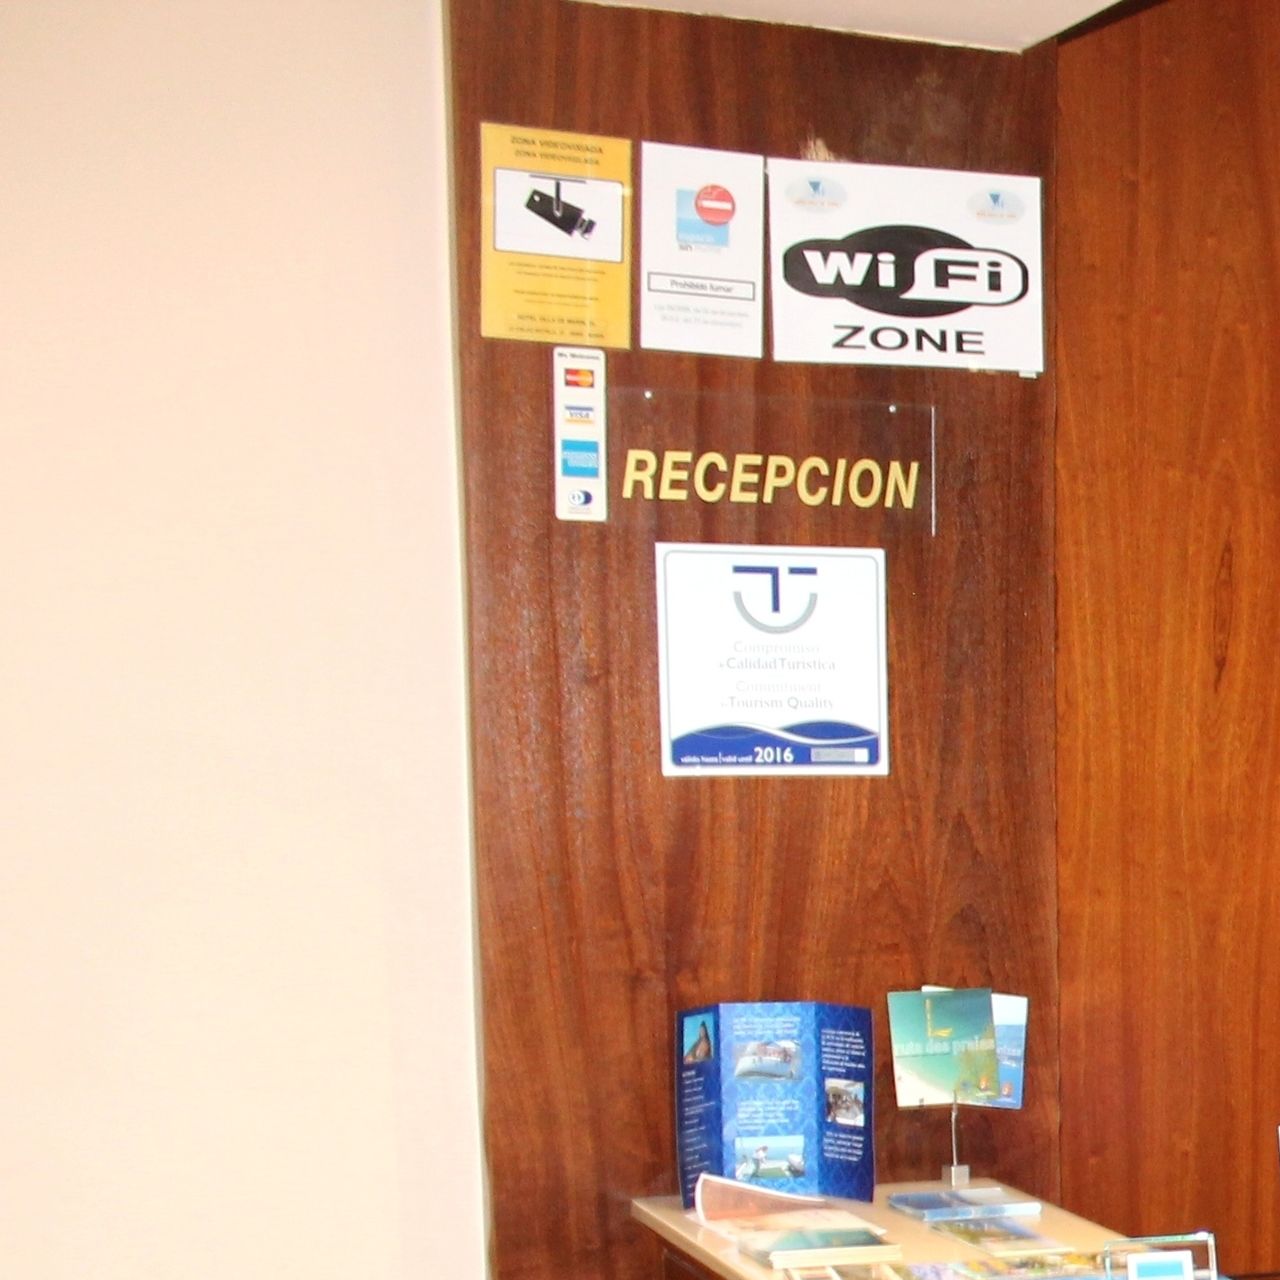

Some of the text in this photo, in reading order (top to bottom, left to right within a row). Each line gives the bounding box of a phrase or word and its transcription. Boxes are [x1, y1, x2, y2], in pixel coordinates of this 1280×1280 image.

[832, 325, 986, 355] ZONE
[622, 449, 919, 509] RECEPCION
[726, 657, 777, 670] Calidad
[728, 695, 784, 709] Tourism
[787, 696, 834, 710] Quality
[754, 747, 794, 763] 2016
